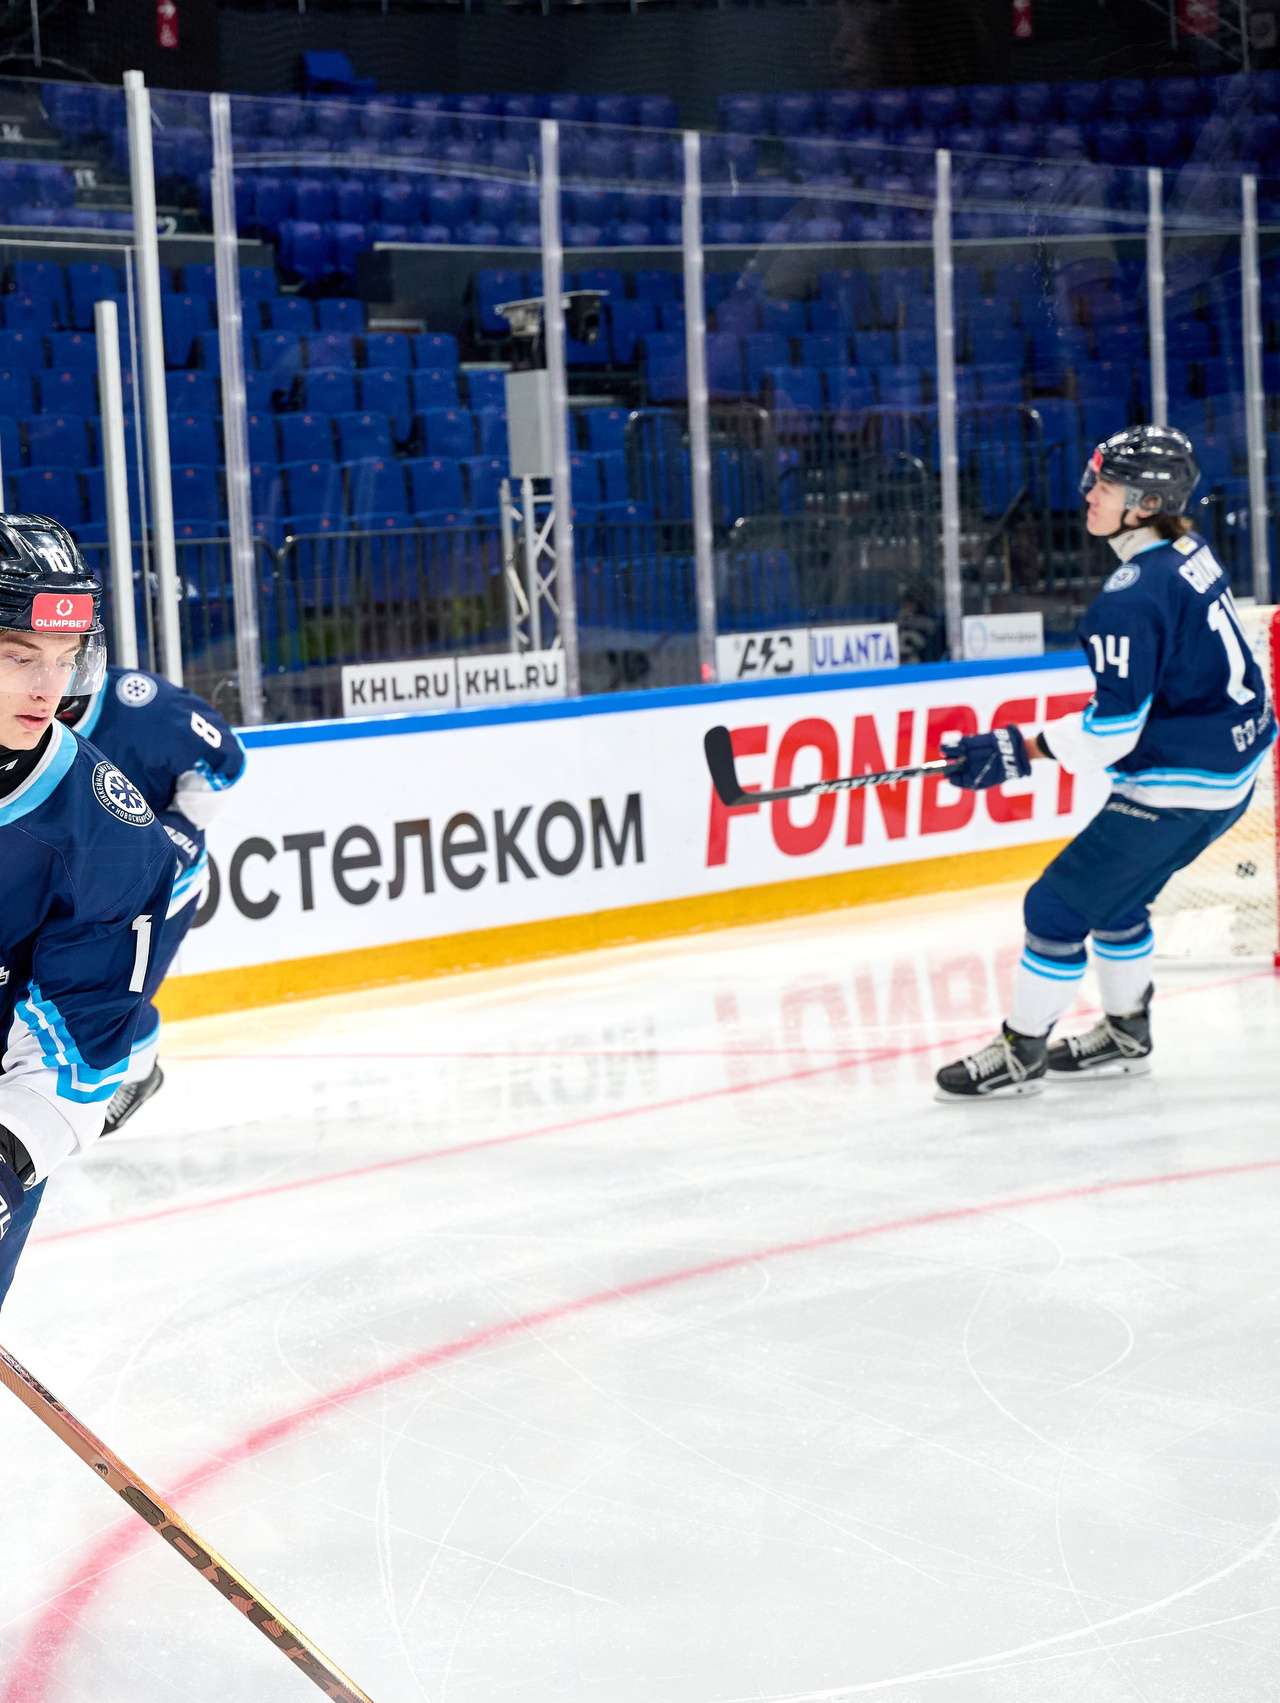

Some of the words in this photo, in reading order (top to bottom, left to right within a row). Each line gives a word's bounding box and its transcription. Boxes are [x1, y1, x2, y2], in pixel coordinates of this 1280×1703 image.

[38, 548, 74, 573] 10
[34, 618, 88, 629] OLIMPBET
[813, 633, 894, 668] ULANTA
[1088, 633, 1130, 679] 14
[350, 672, 450, 705] KHL.RU
[465, 662, 559, 696] KHL.RU
